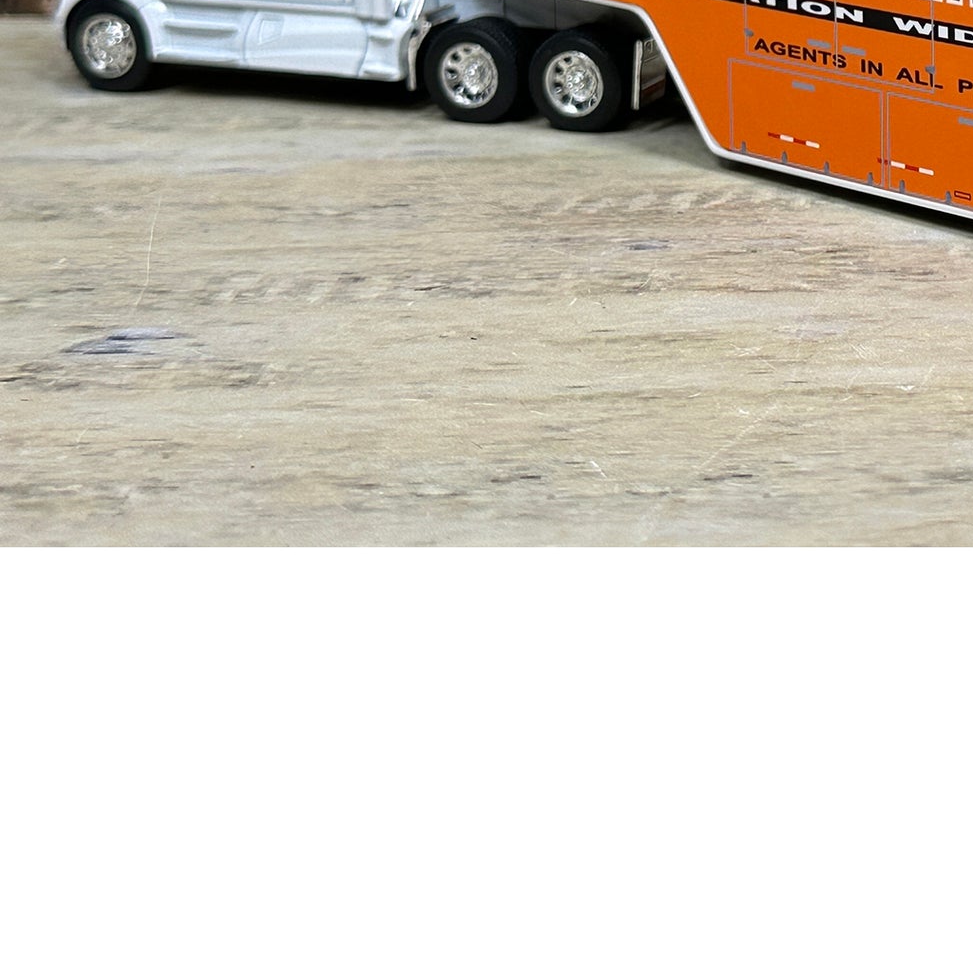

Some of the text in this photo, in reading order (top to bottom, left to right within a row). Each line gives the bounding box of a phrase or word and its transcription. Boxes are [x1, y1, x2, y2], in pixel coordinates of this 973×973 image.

[754, 38, 847, 68] AGENTS
[861, 58, 883, 77] IN
[896, 67, 943, 89] ALL
